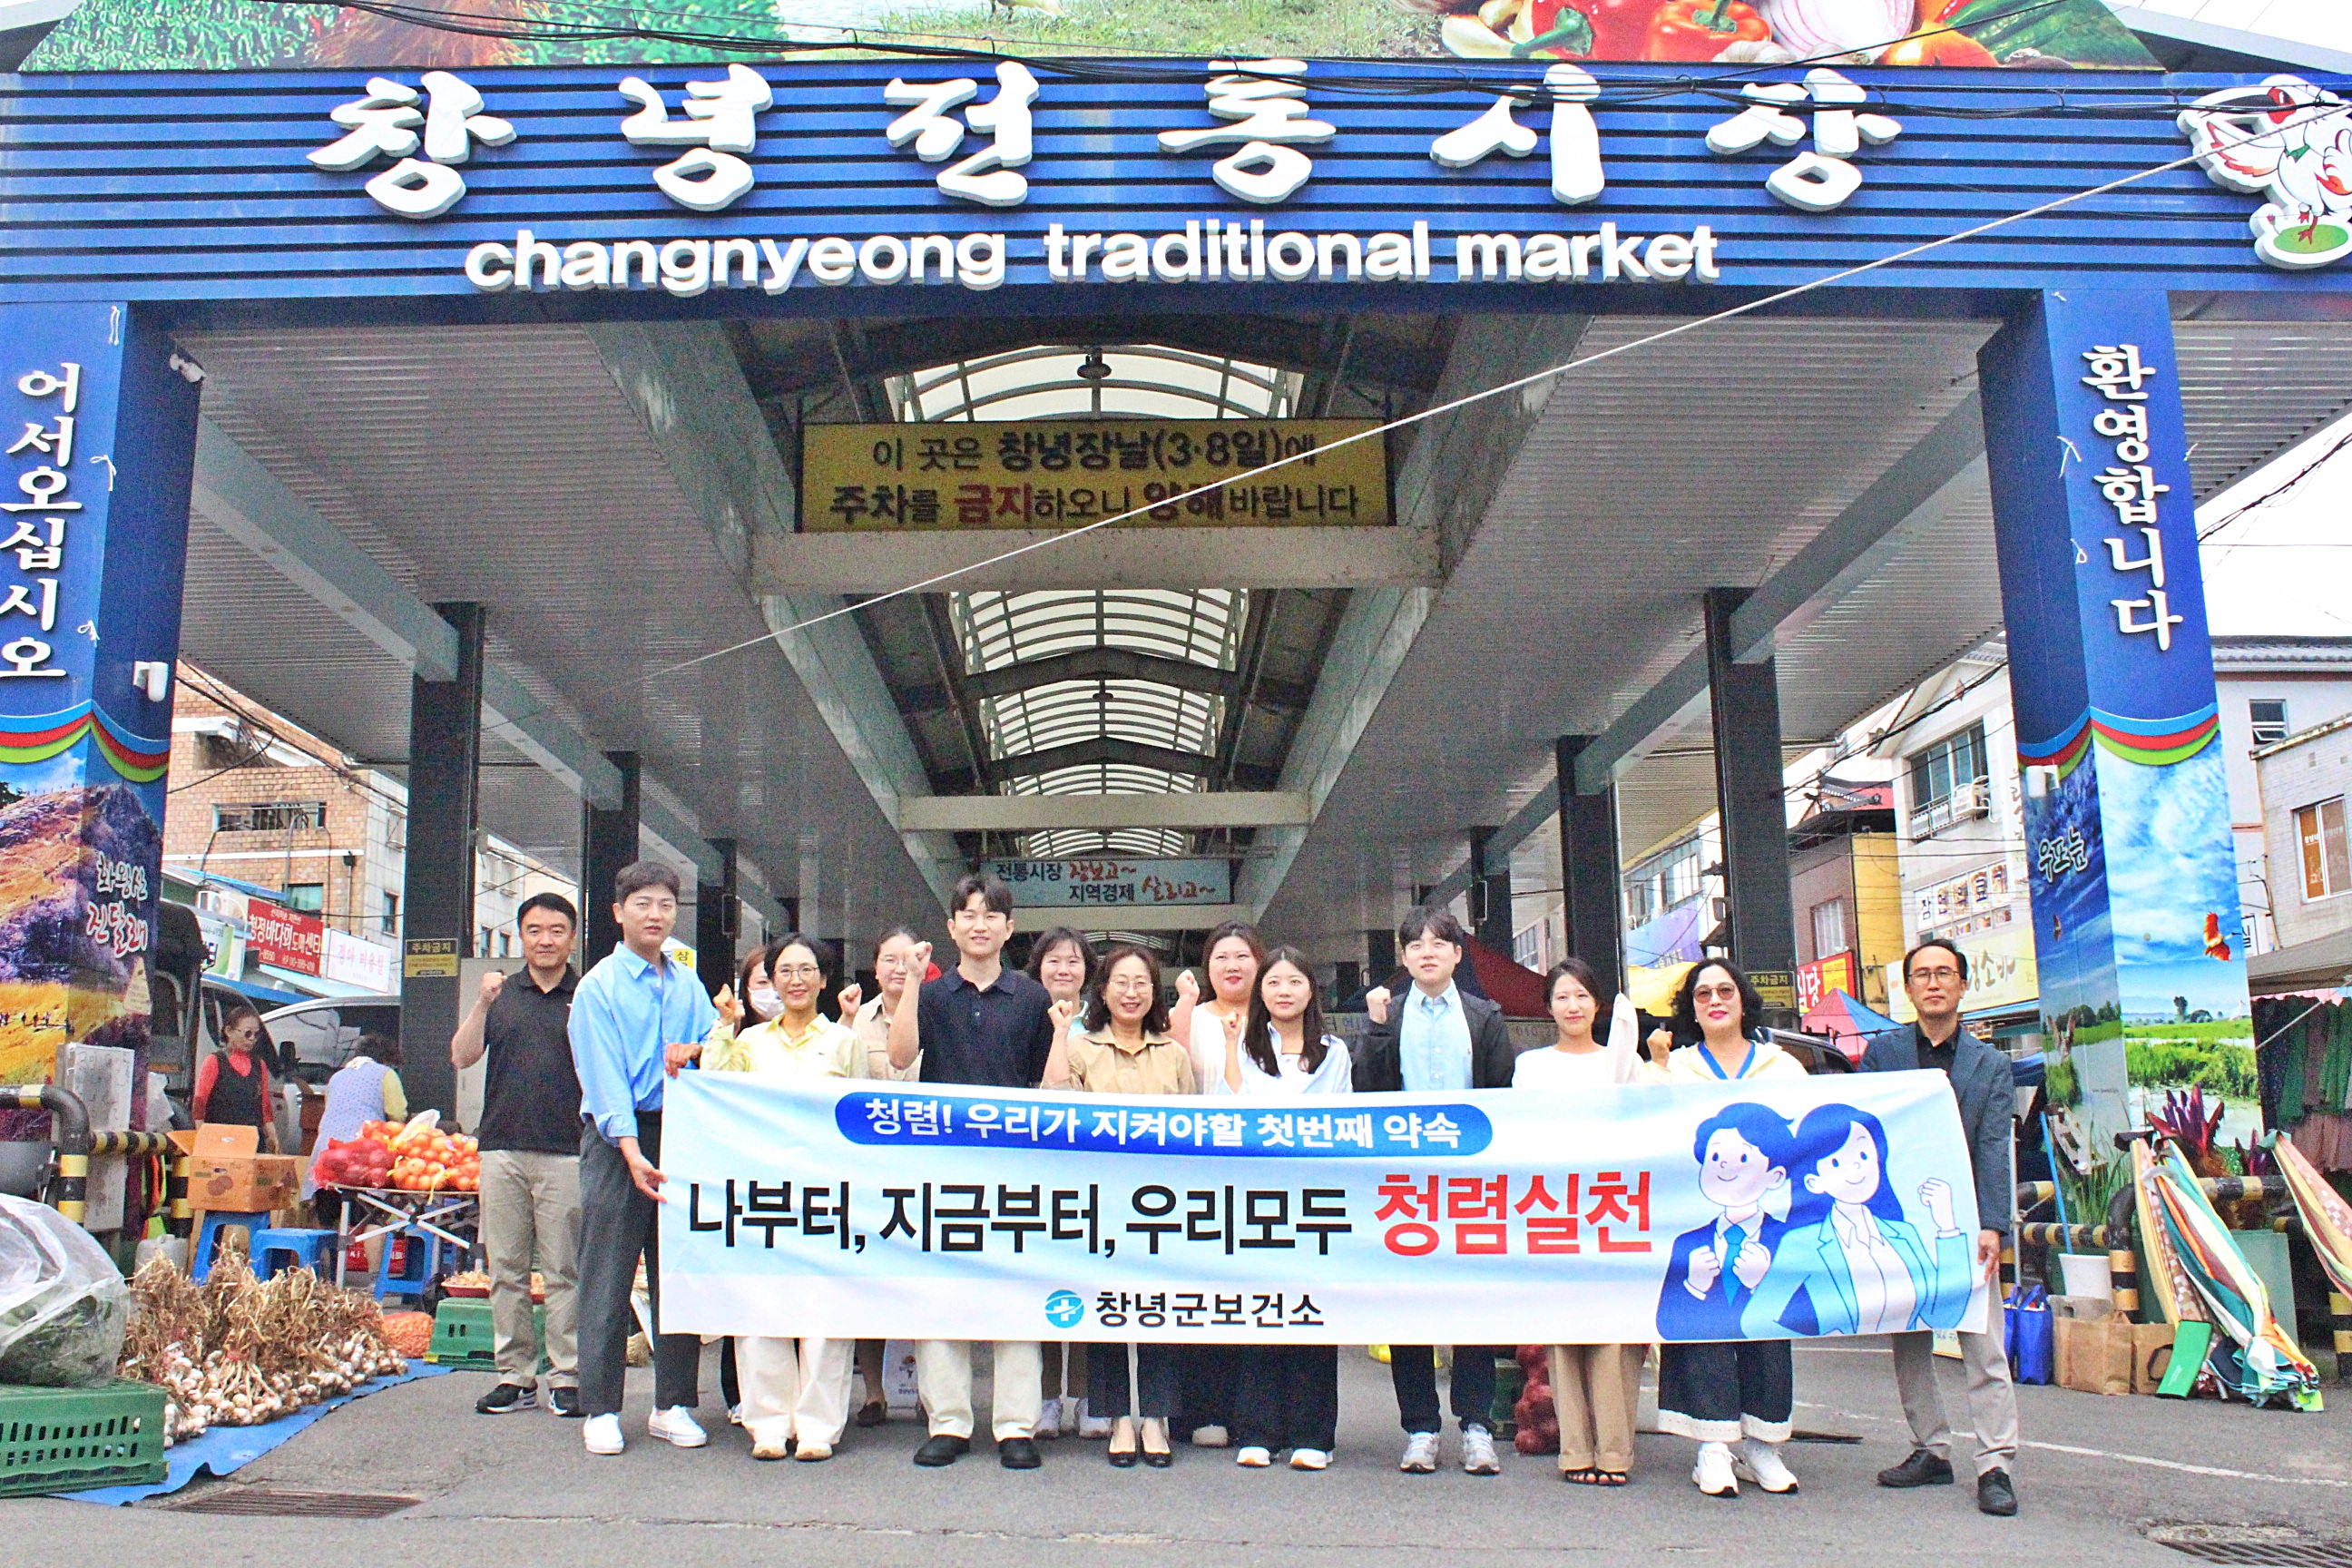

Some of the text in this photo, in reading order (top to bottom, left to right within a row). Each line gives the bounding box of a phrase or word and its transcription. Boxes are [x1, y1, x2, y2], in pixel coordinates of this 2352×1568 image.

[465, 220, 1720, 297] changnyeong traditional market
[872, 437, 903, 472] 이
[917, 437, 984, 471] 곳은
[0, 362, 83, 679] 어서오십시오
[829, 484, 942, 524] 주차를
[954, 483, 1132, 524] 금지하오니
[2082, 344, 2184, 652] 환영합니다
[97, 851, 148, 901] 화왕산
[997, 863, 1062, 882] 전통시장
[2039, 826, 2087, 883] 우포늪
[1069, 883, 1134, 903] 지역경제
[86, 900, 148, 958] 진달래
[412, 942, 451, 953] 주차금지
[1750, 975, 1788, 985] 주차금지
[864, 1097, 1463, 1150] 청렴! 우리가 지켜야할 첫번째 약속
[1126, 1185, 1352, 1255] 우리모두
[1375, 1171, 1653, 1257] 청렴실천
[1095, 1291, 1325, 1328] 창녕군보건소
